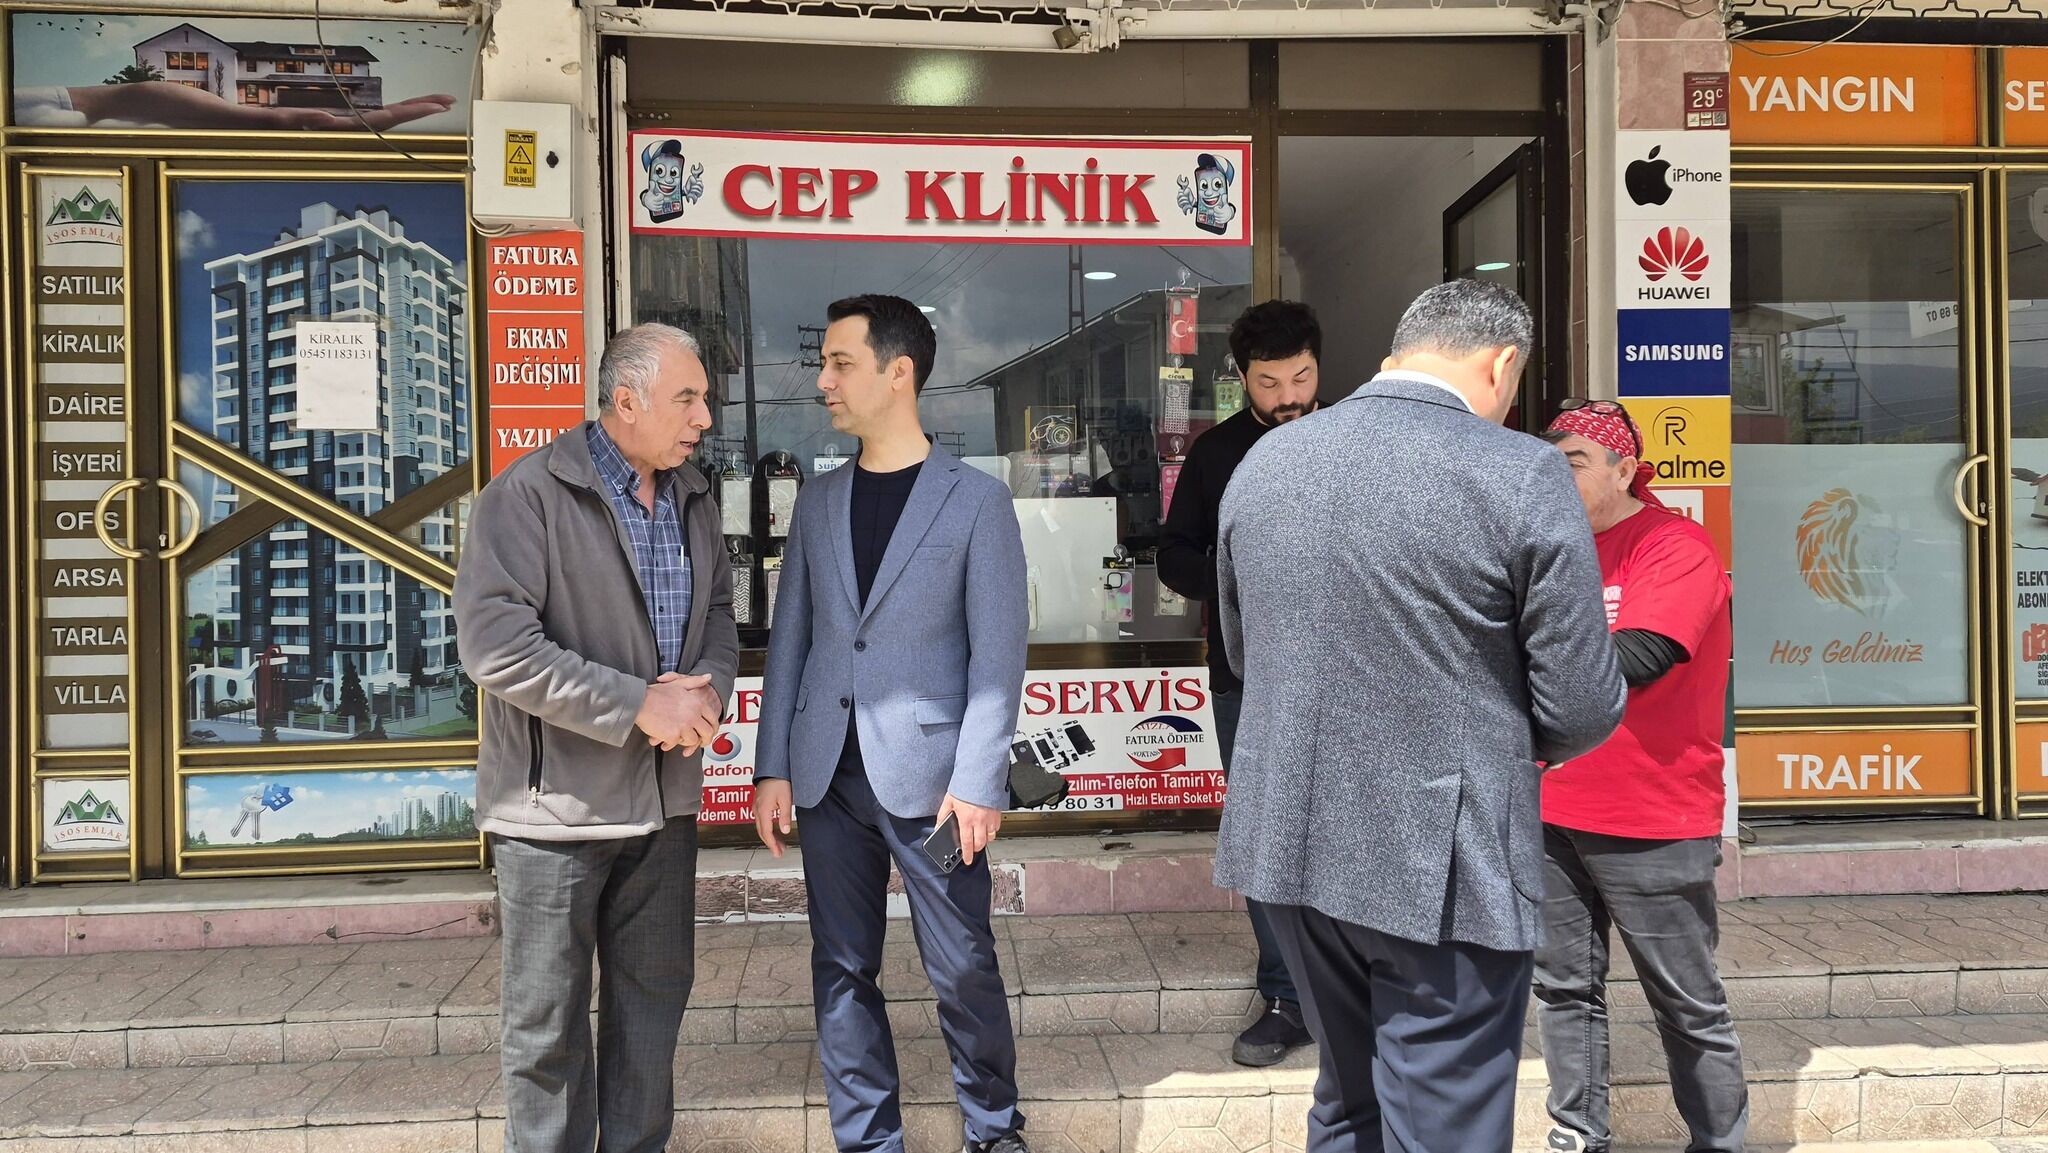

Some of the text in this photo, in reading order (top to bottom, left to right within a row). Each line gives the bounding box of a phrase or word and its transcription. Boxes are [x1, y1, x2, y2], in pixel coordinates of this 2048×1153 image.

[1738, 75, 1915, 113] YANGIN
[2004, 79, 2048, 112] SE
[1672, 168, 1722, 182] iPhone
[721, 155, 1160, 224] CEP KLİNİK
[492, 246, 579, 266] FATURA
[42, 275, 124, 295] SATILIK
[493, 270, 578, 296] ÖDEME
[1638, 287, 1710, 300] HUAWEI
[42, 330, 124, 353] KİRALIK
[309, 332, 364, 345] KİRALIK
[506, 327, 568, 349] EKRAN
[299, 348, 372, 360] 05451183131
[1625, 344, 1724, 361] SAMSUNG
[494, 355, 581, 391] DEĞİŞİMİ
[48, 392, 124, 415] DAİRE
[52, 450, 122, 477] İŞYERİ
[55, 511, 120, 531] OFS
[53, 568, 124, 587] ARSA
[2017, 593, 2048, 608] ABON
[51, 626, 127, 647] TARLA
[1769, 631, 1924, 666] Hoş Geldiniz
[54, 682, 127, 705] VİLLA
[1023, 670, 1206, 716] SERVİS
[1125, 732, 1205, 745] FATURA ÖDEME
[1776, 743, 1923, 791] TRAFİK
[1068, 771, 1228, 791] zılım-Telefon Tamiri Ya
[708, 786, 751, 804] Tamir
[1065, 798, 1088, 810] 80
[1094, 797, 1114, 809] 31
[1126, 793, 1148, 806] Hızlı
[1151, 793, 1180, 805] Ekran
[1183, 792, 1213, 804] Soket
[84, 825, 122, 840] EMLAK
